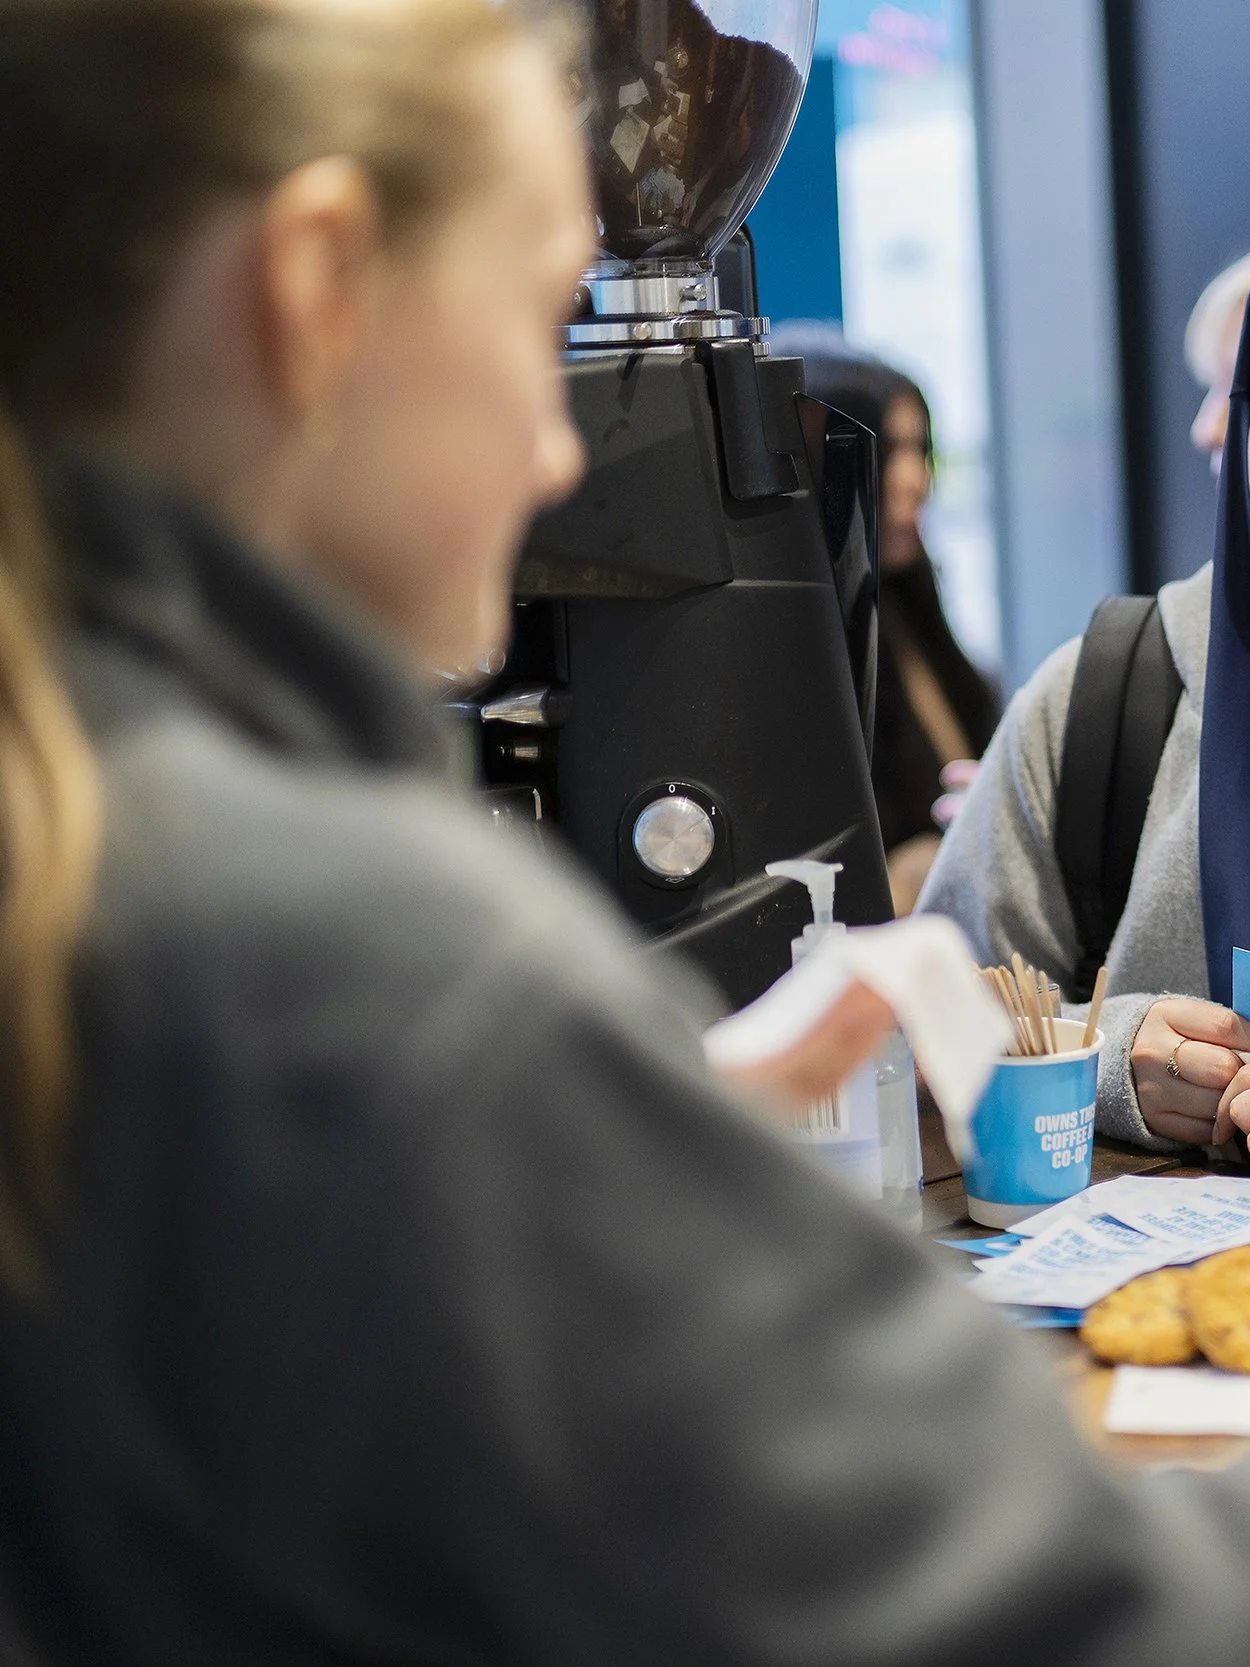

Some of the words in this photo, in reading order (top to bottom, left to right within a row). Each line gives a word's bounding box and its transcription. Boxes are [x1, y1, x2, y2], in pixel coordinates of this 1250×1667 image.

[1034, 1110, 1078, 1133] OWNS
[1041, 1125, 1087, 1152] COFFEE
[1052, 1143, 1088, 1168] CO-OP
